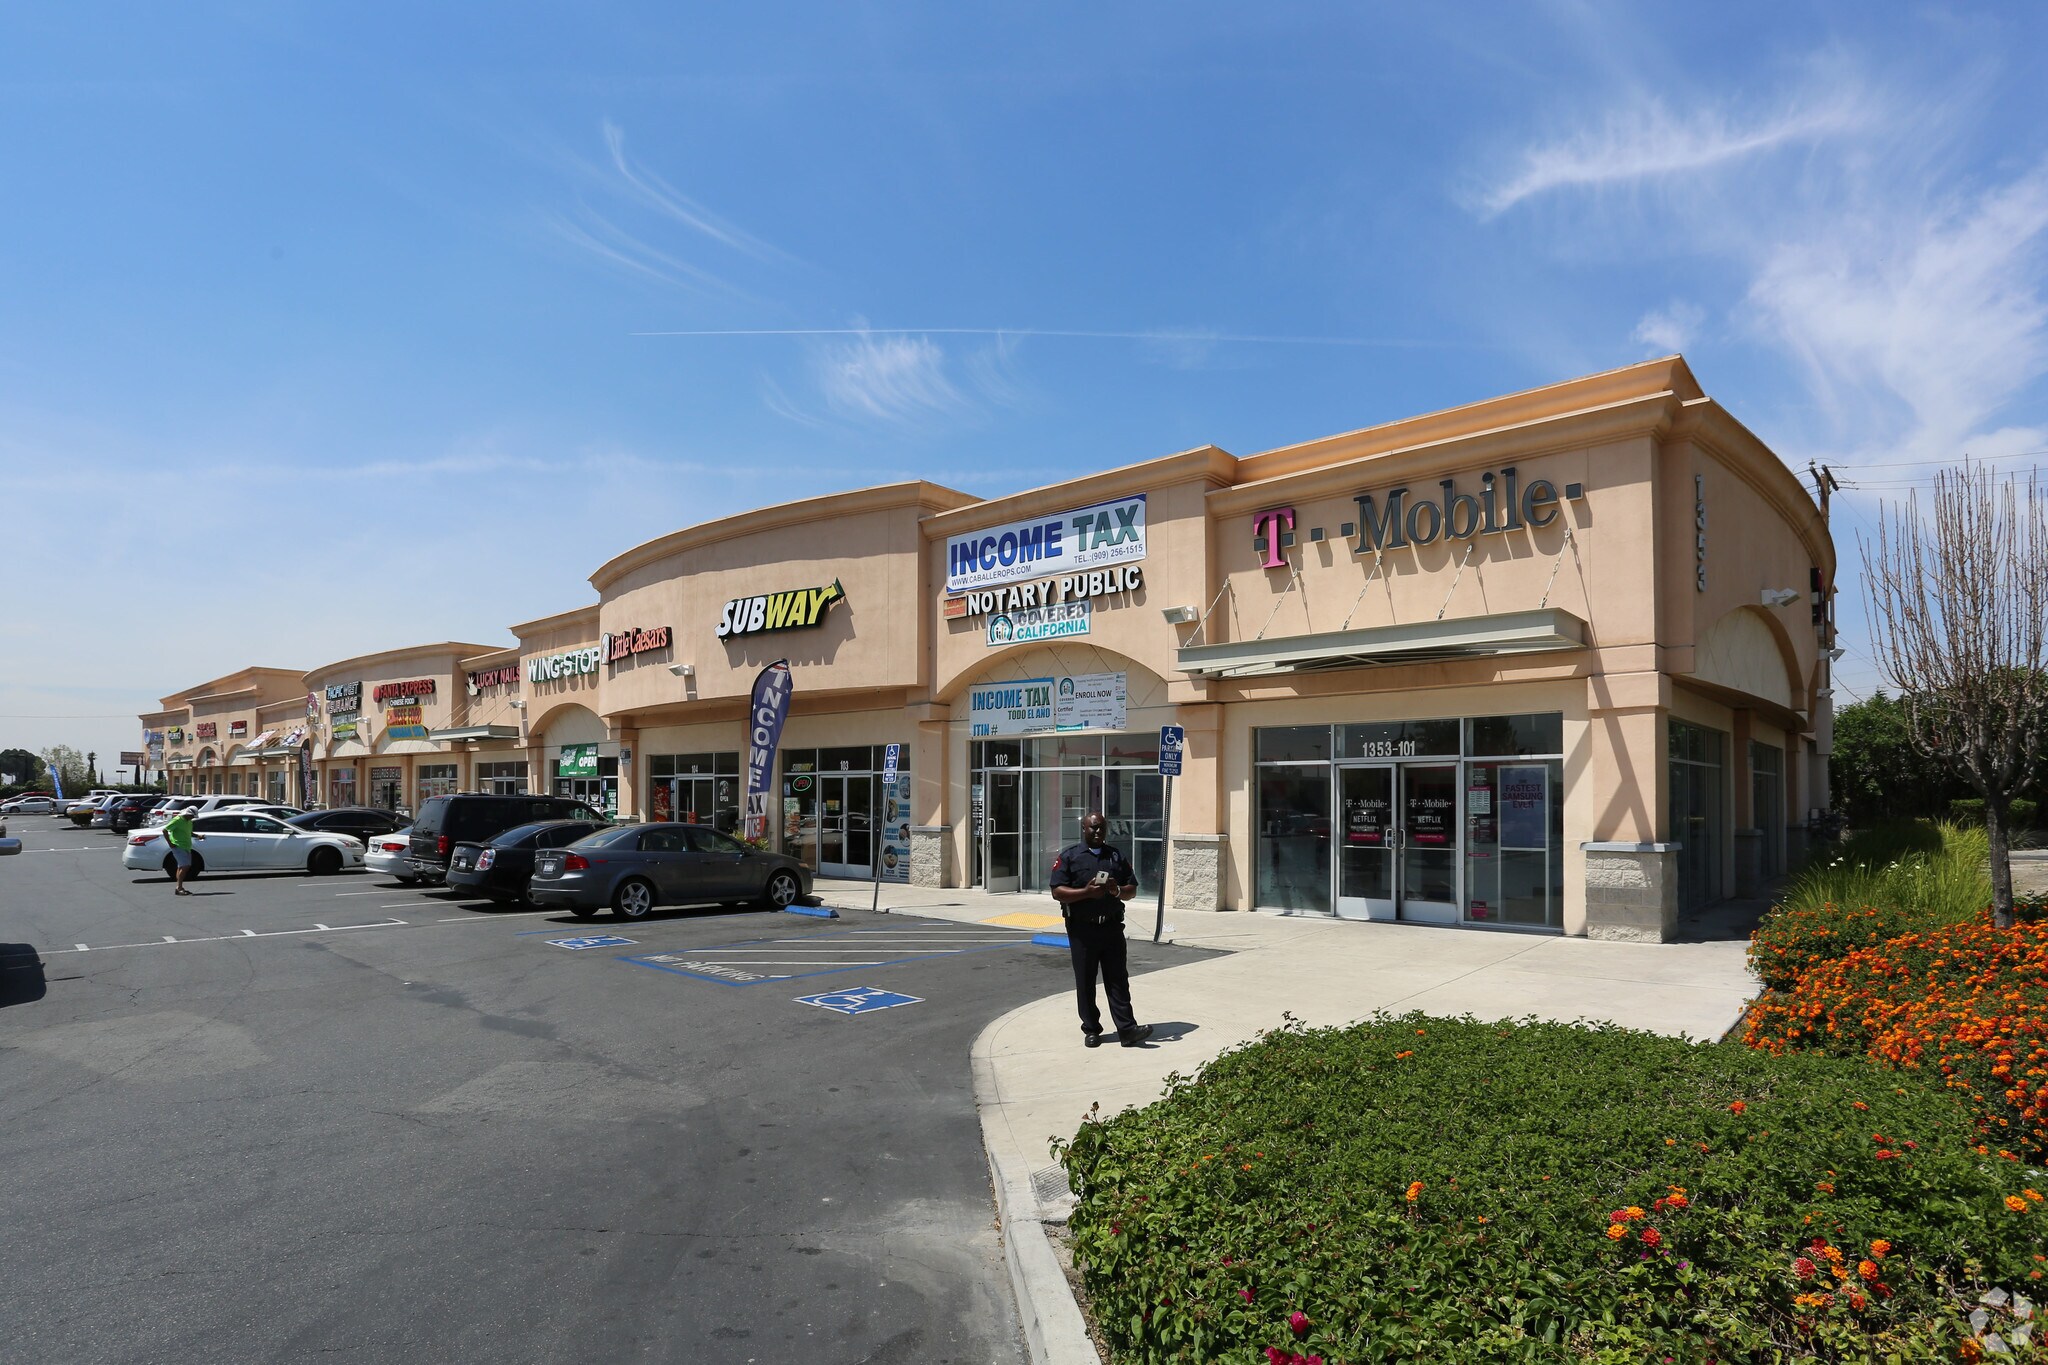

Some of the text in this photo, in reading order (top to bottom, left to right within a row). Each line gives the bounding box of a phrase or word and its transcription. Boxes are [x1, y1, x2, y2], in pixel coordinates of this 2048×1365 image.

[1353, 466, 1559, 556] Mobile
[951, 504, 1140, 577] INCOME TAX
[1111, 544, 1143, 558] 256-1515
[951, 565, 1032, 587] WWW.CABALLEROPS.COM
[968, 582, 1052, 616] NOTARY
[1061, 565, 1140, 601] PUBLIC
[714, 583, 840, 639] SUBWAY
[1017, 603, 1086, 627] COVERED
[1016, 619, 1087, 640] CALIFORNIA
[610, 626, 667, 661] Little Caesars
[476, 666, 520, 688] LUCKY NAILS
[400, 679, 433, 696] EXPRESS
[1075, 690, 1113, 699] ENROLL NOW
[390, 699, 405, 707] CHINESE
[972, 686, 1051, 711] INCOME TAX
[1007, 709, 1026, 720] TODO
[1027, 708, 1034, 719] EL
[748, 670, 787, 789] INCOME
[973, 723, 990, 737] ITIN
[1362, 740, 1416, 757] 1353-101
[578, 756, 597, 767] OPEN
[994, 753, 1008, 767] 102
[1502, 792, 1543, 801] SAMSUNG
[1505, 784, 1541, 792] FASTEST
[747, 795, 763, 815] AX
[1352, 815, 1377, 823] NETFLIX
[1417, 815, 1442, 824] NETFLIX
